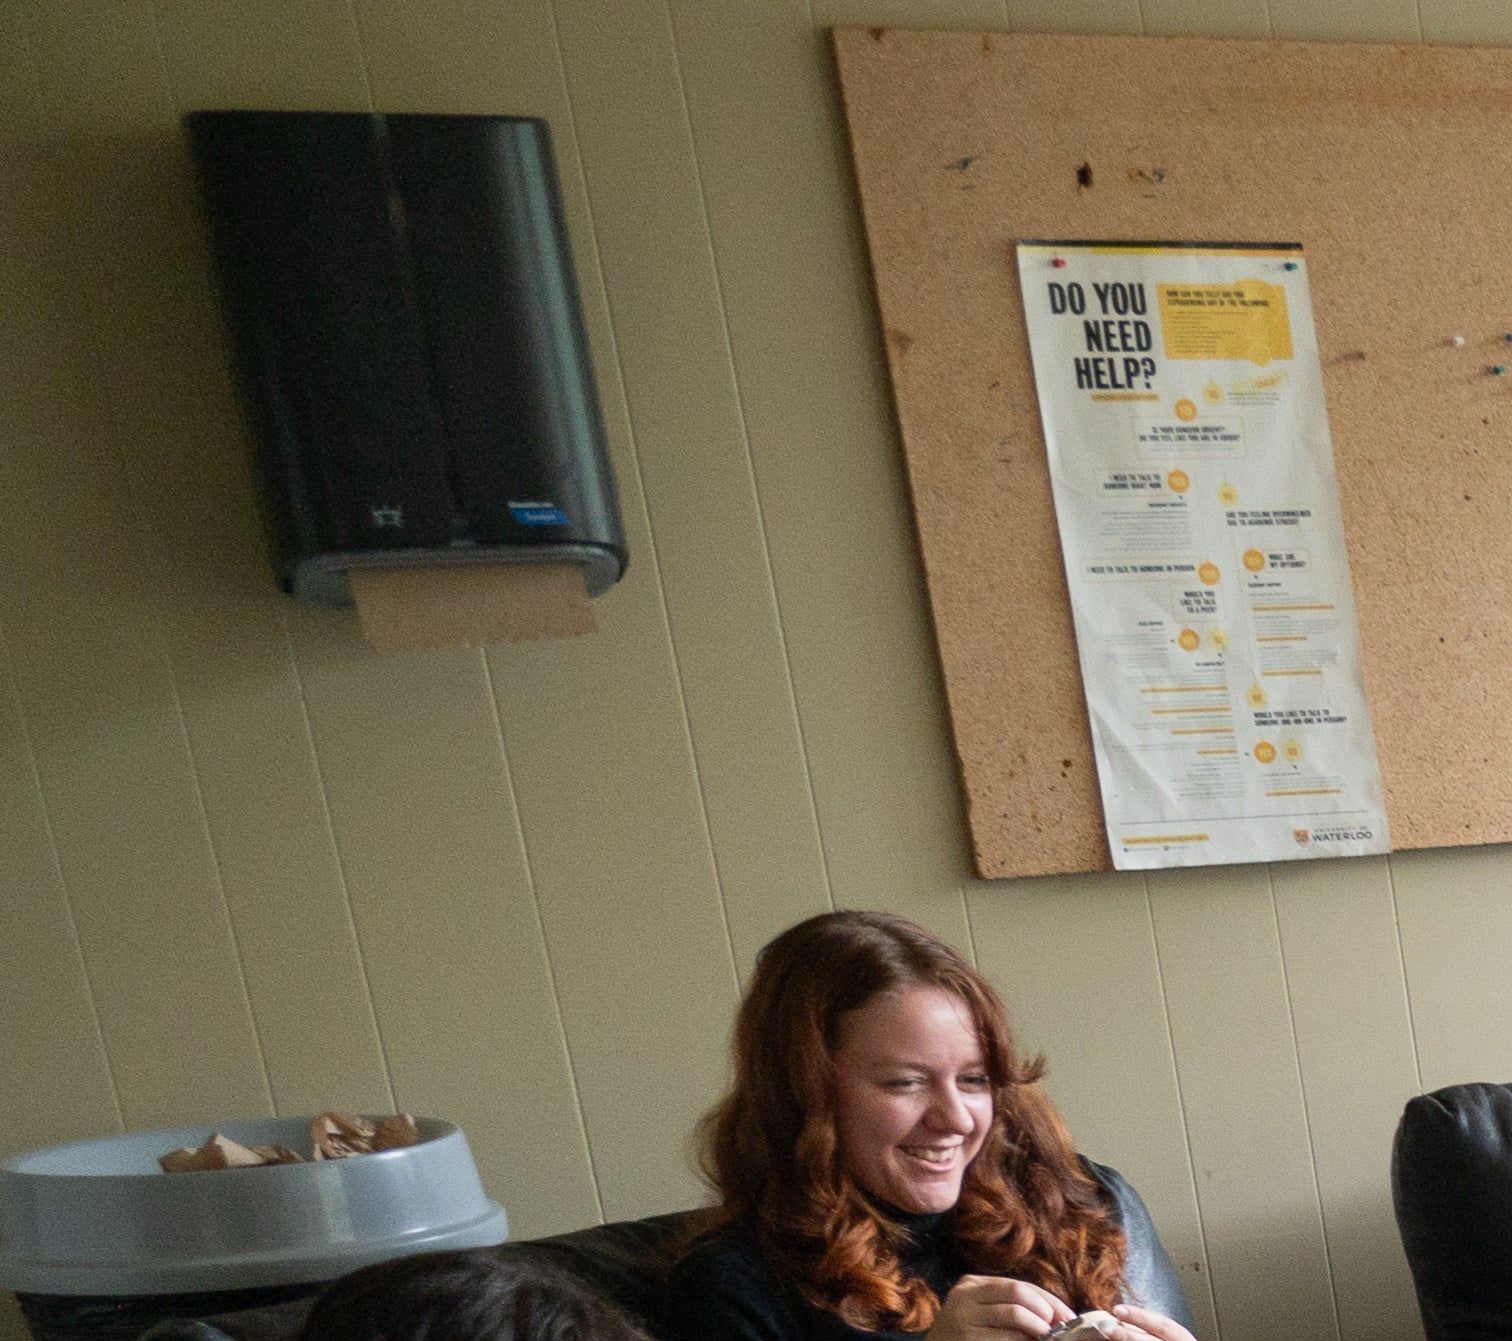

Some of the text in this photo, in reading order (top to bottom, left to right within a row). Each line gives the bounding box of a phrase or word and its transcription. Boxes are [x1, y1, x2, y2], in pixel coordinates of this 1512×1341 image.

[1048, 282, 1147, 315] DO YOU
[1084, 320, 1152, 352] NEED
[1074, 357, 1156, 389] HELP?
[1312, 831, 1372, 841] WATERLOO
